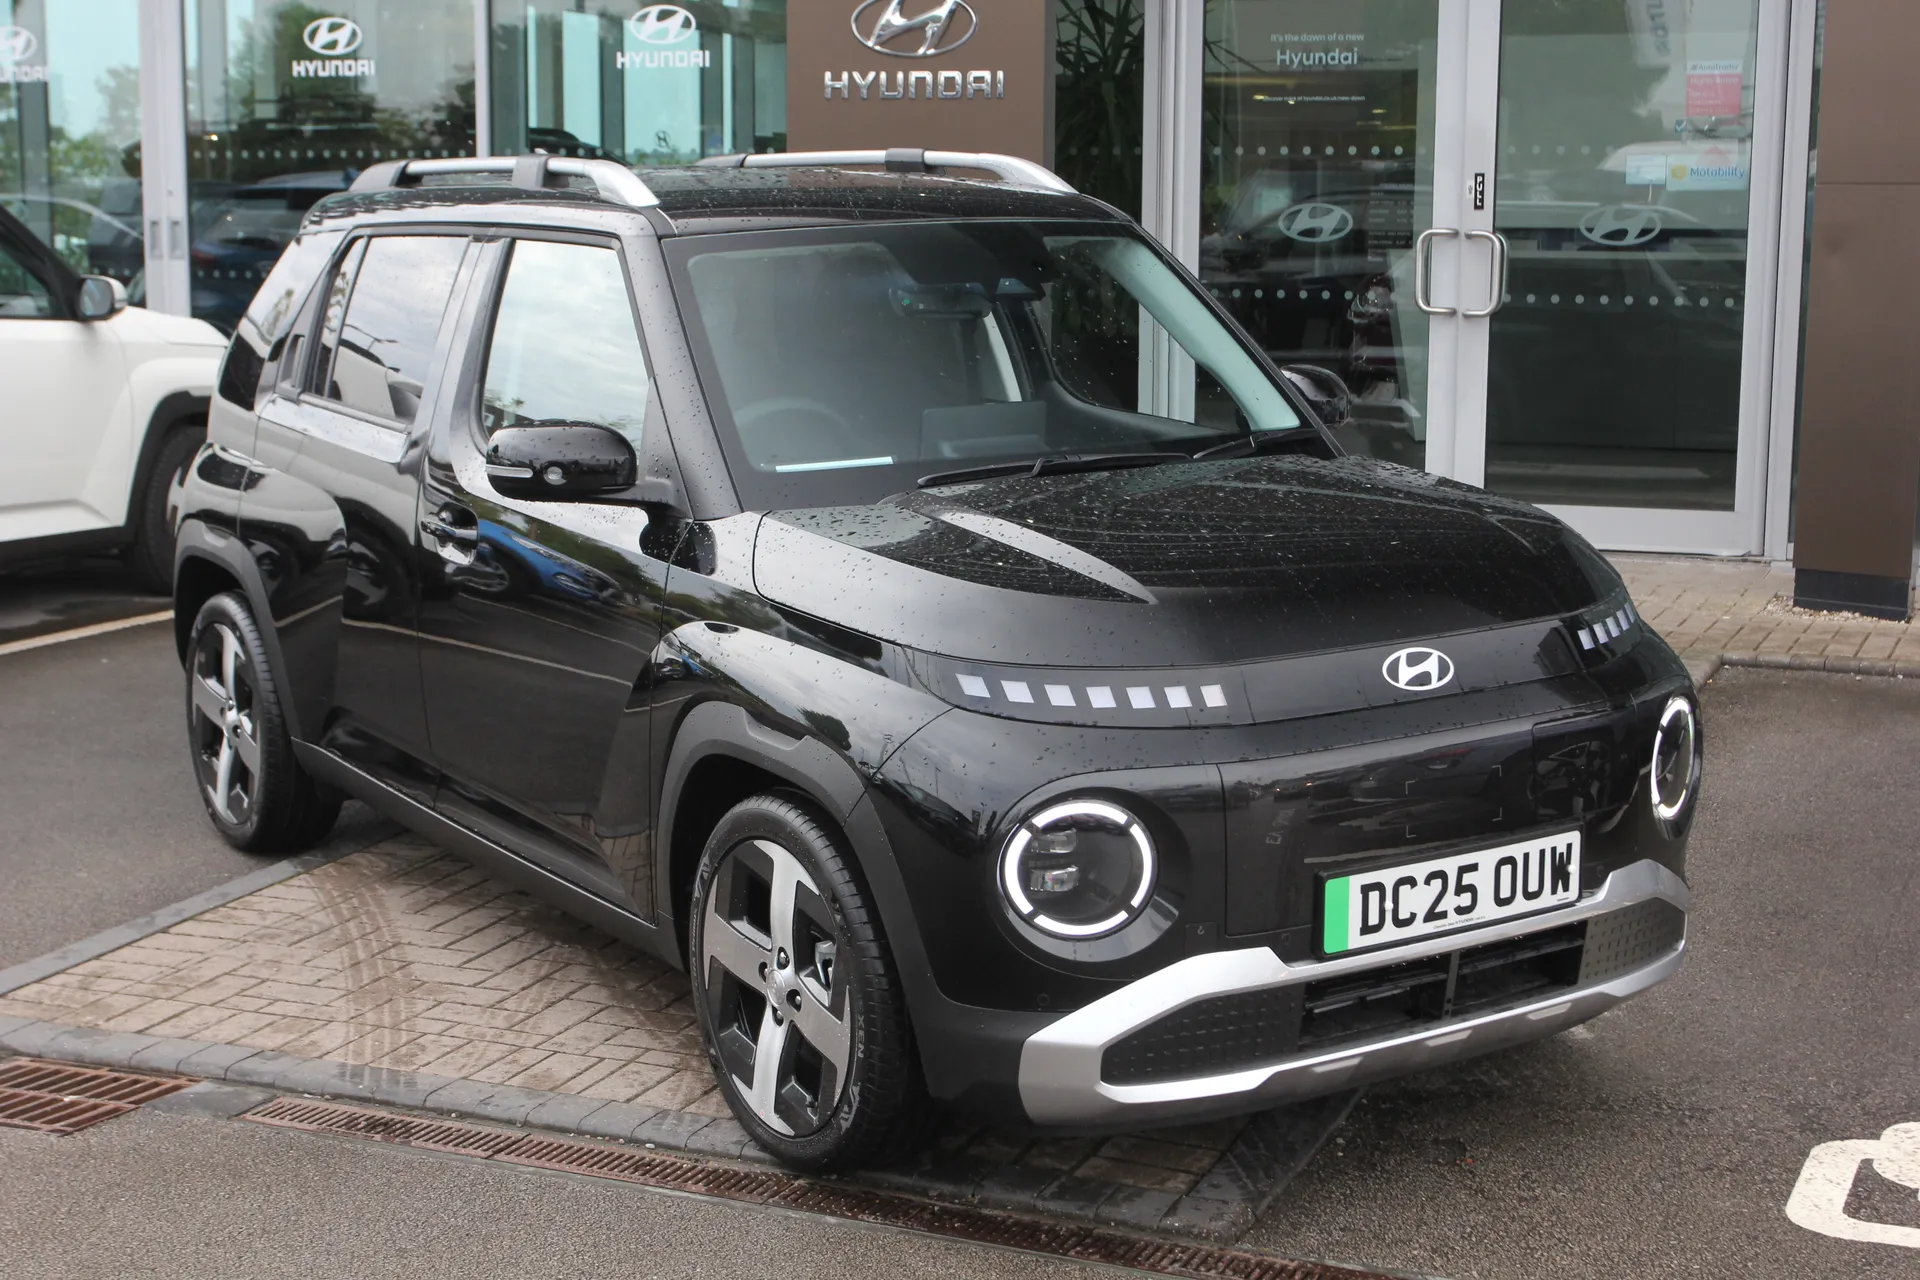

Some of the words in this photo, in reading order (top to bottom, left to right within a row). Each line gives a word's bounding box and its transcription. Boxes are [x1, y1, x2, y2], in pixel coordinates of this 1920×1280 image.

[1271, 33, 1283, 42] It's
[1285, 33, 1299, 42] the
[1300, 32, 1326, 41] dawn
[1327, 32, 1337, 41] of
[1345, 33, 1365, 41] new
[616, 50, 710, 69] HYUNDAI
[1276, 47, 1358, 68] Hyundai
[292, 59, 376, 78] HYUNDAI
[824, 70, 1004, 99] HYUNDAI
[1690, 167, 1745, 179] Motability
[1360, 862, 1479, 936] DC25
[1494, 842, 1573, 907] OUW
